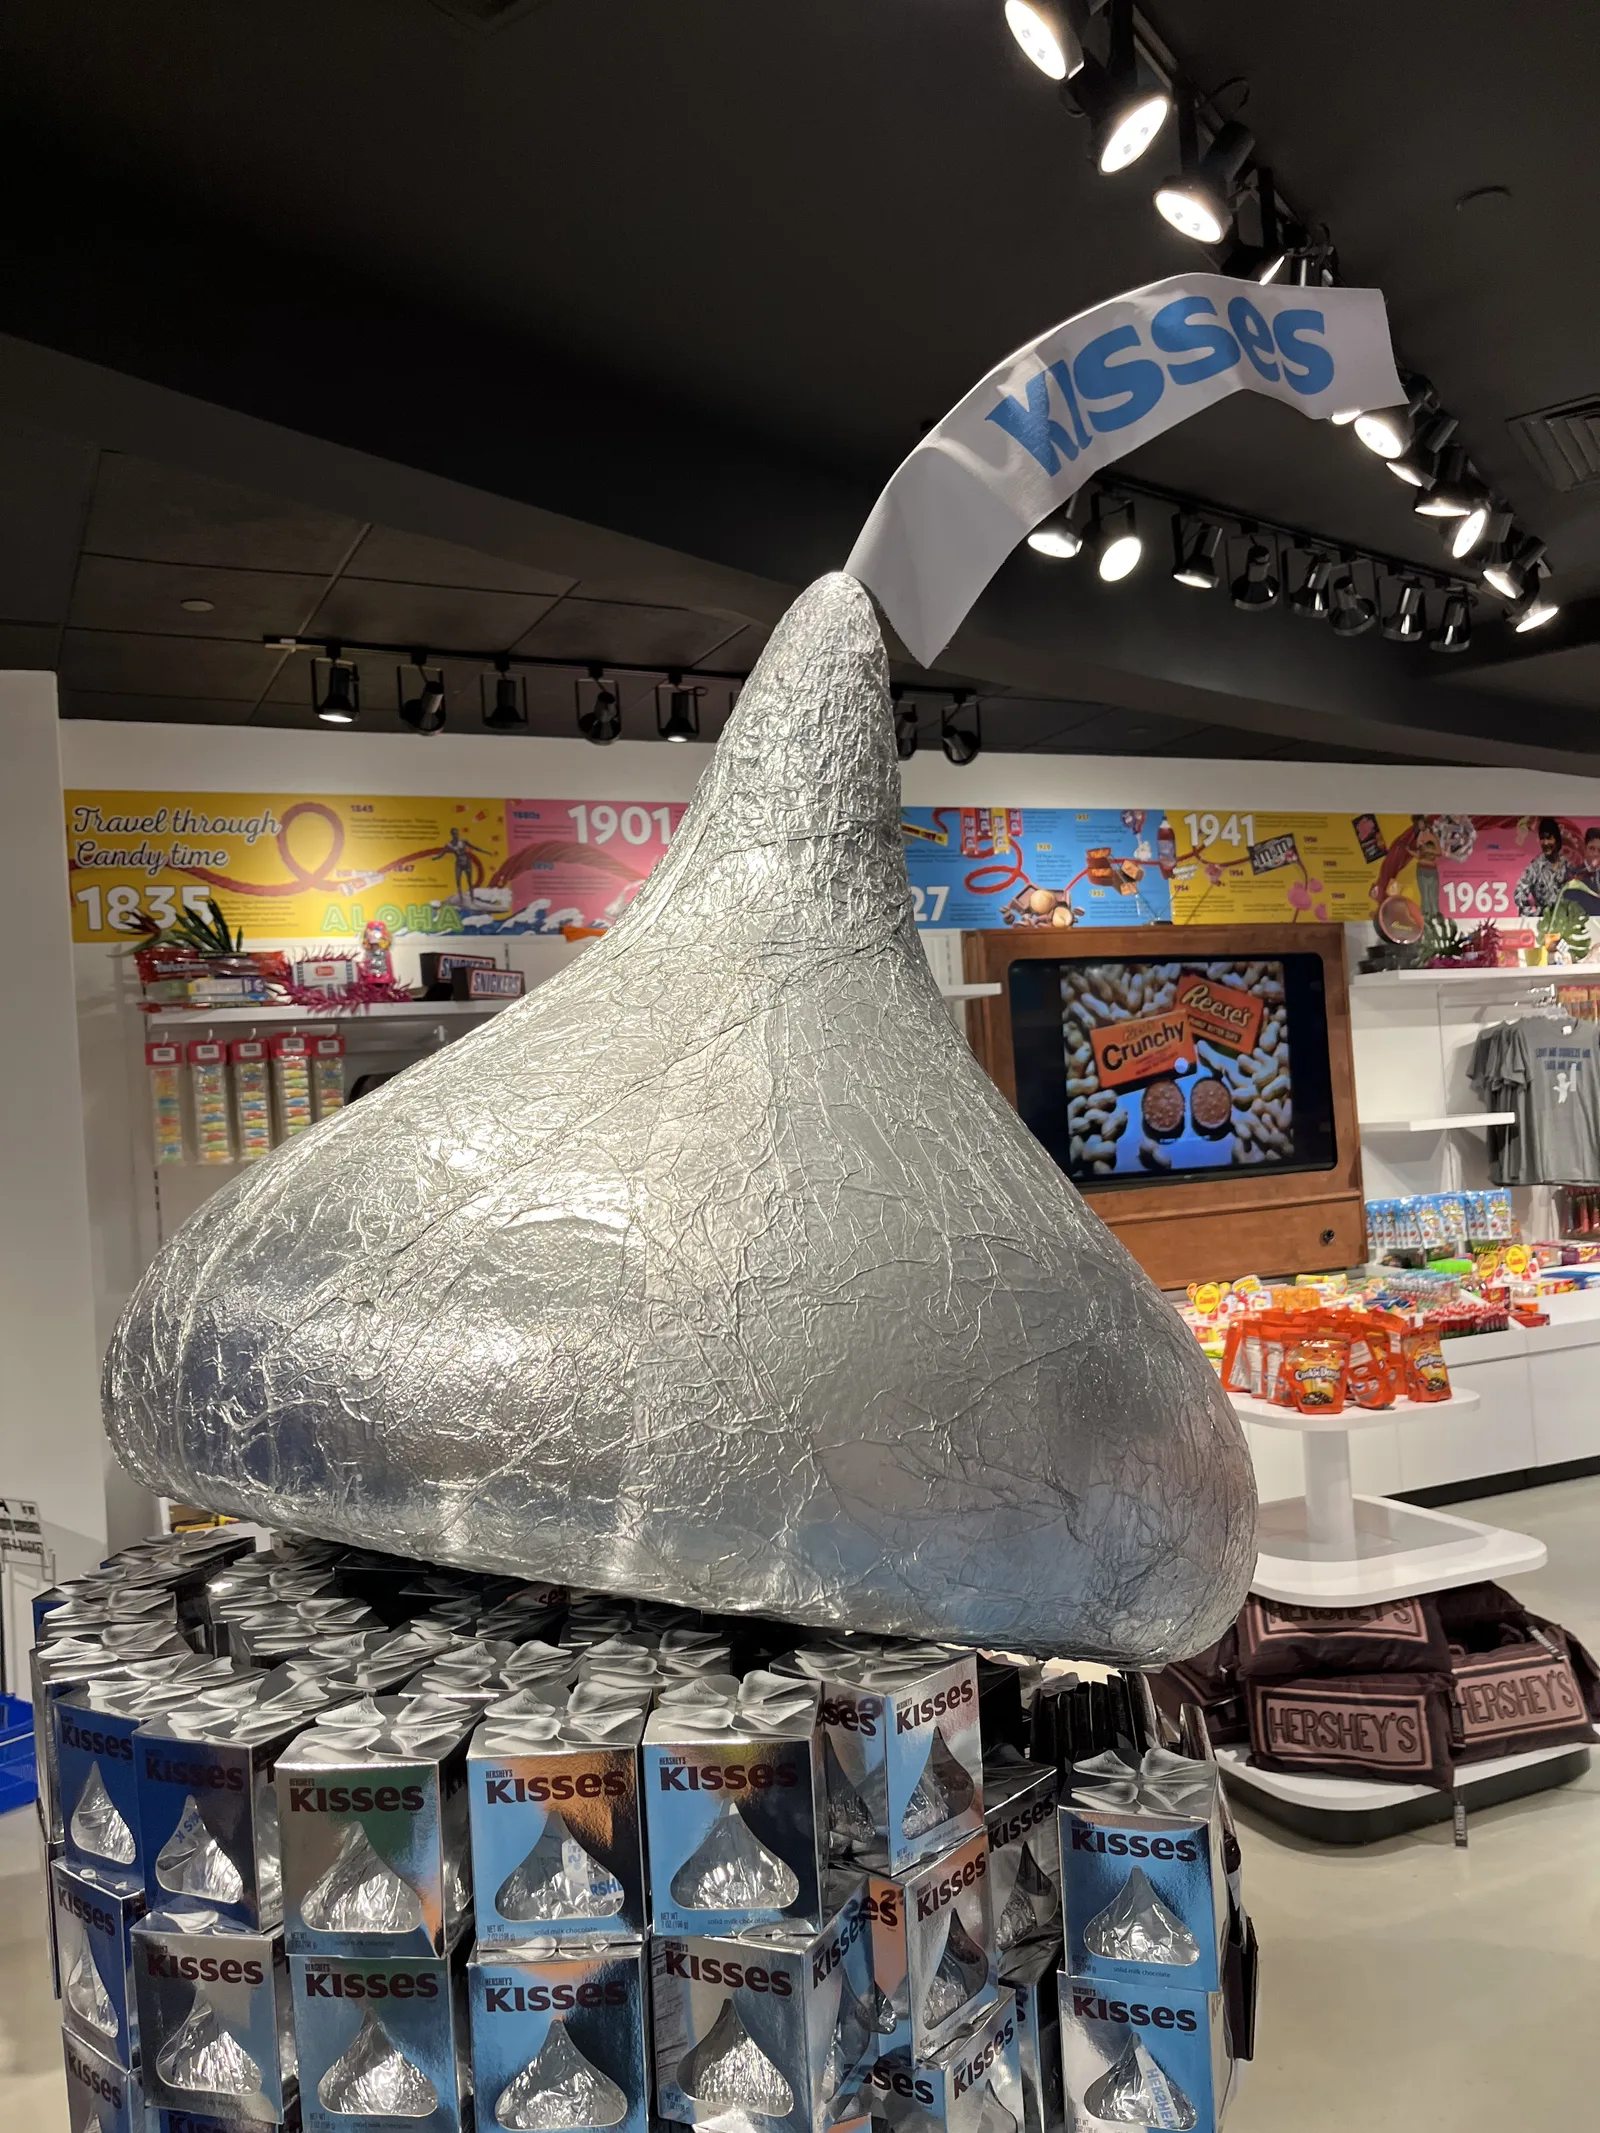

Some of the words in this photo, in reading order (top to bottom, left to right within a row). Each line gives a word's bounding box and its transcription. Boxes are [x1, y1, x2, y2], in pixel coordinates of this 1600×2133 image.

[74, 806, 166, 834] Travel
[171, 809, 281, 843] through
[568, 804, 672, 845] 1901
[1184, 813, 1256, 847] 1941
[76, 841, 168, 876] Candy
[170, 843, 229, 868] time
[77, 885, 214, 931] 1835
[1443, 881, 1509, 913] 1963
[321, 903, 464, 932] ALOHA
[474, 972, 519, 994] SNICKERS
[1181, 983, 1254, 1027] Reese's
[1102, 1020, 1185, 1071] Crunchy
[1460, 1670, 1577, 1726] HERSHEY'S
[1269, 1706, 1418, 1754] HERSHEY'S
[485, 1769, 513, 1779] HERSHEY'S
